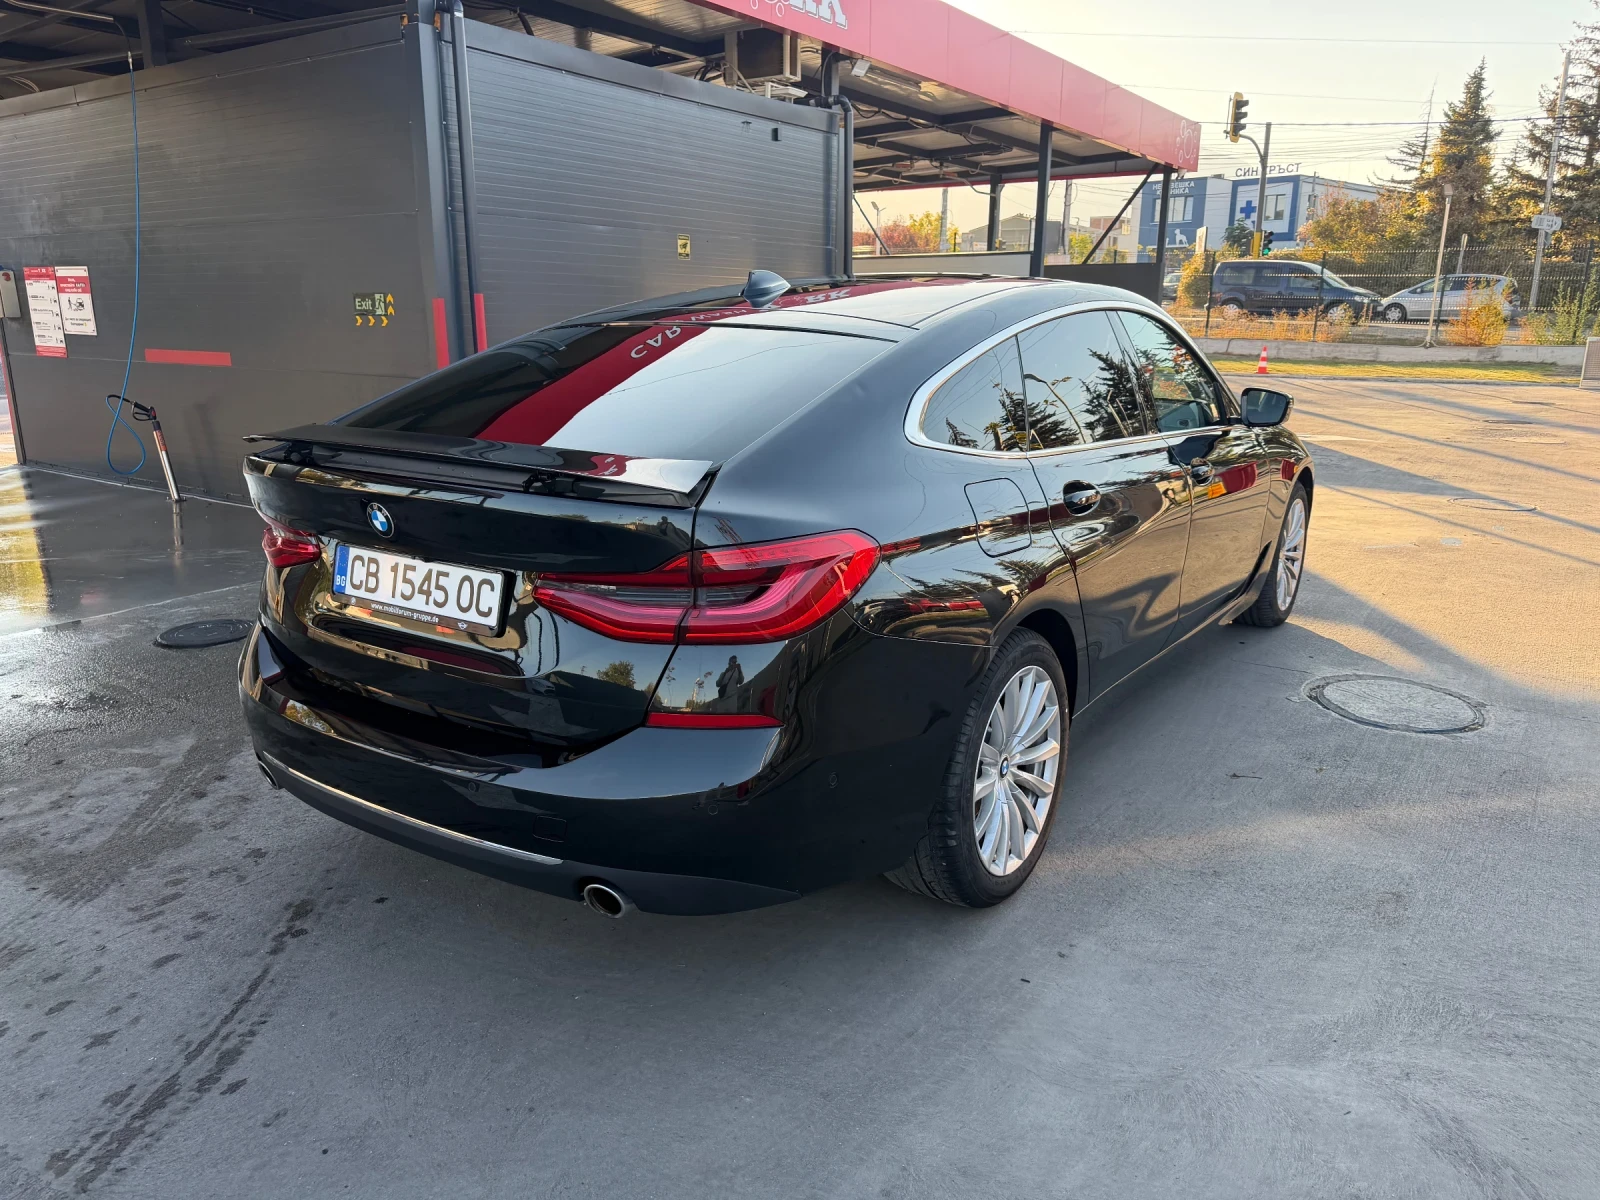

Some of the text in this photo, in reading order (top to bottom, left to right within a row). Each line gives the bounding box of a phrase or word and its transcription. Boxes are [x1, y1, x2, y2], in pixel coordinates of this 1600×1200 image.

[1235, 162, 1302, 178] СИН РЪСТ
[355, 298, 373, 310] Exit
[336, 575, 346, 587] BG
[349, 554, 381, 594] CB
[390, 562, 451, 609] 1545
